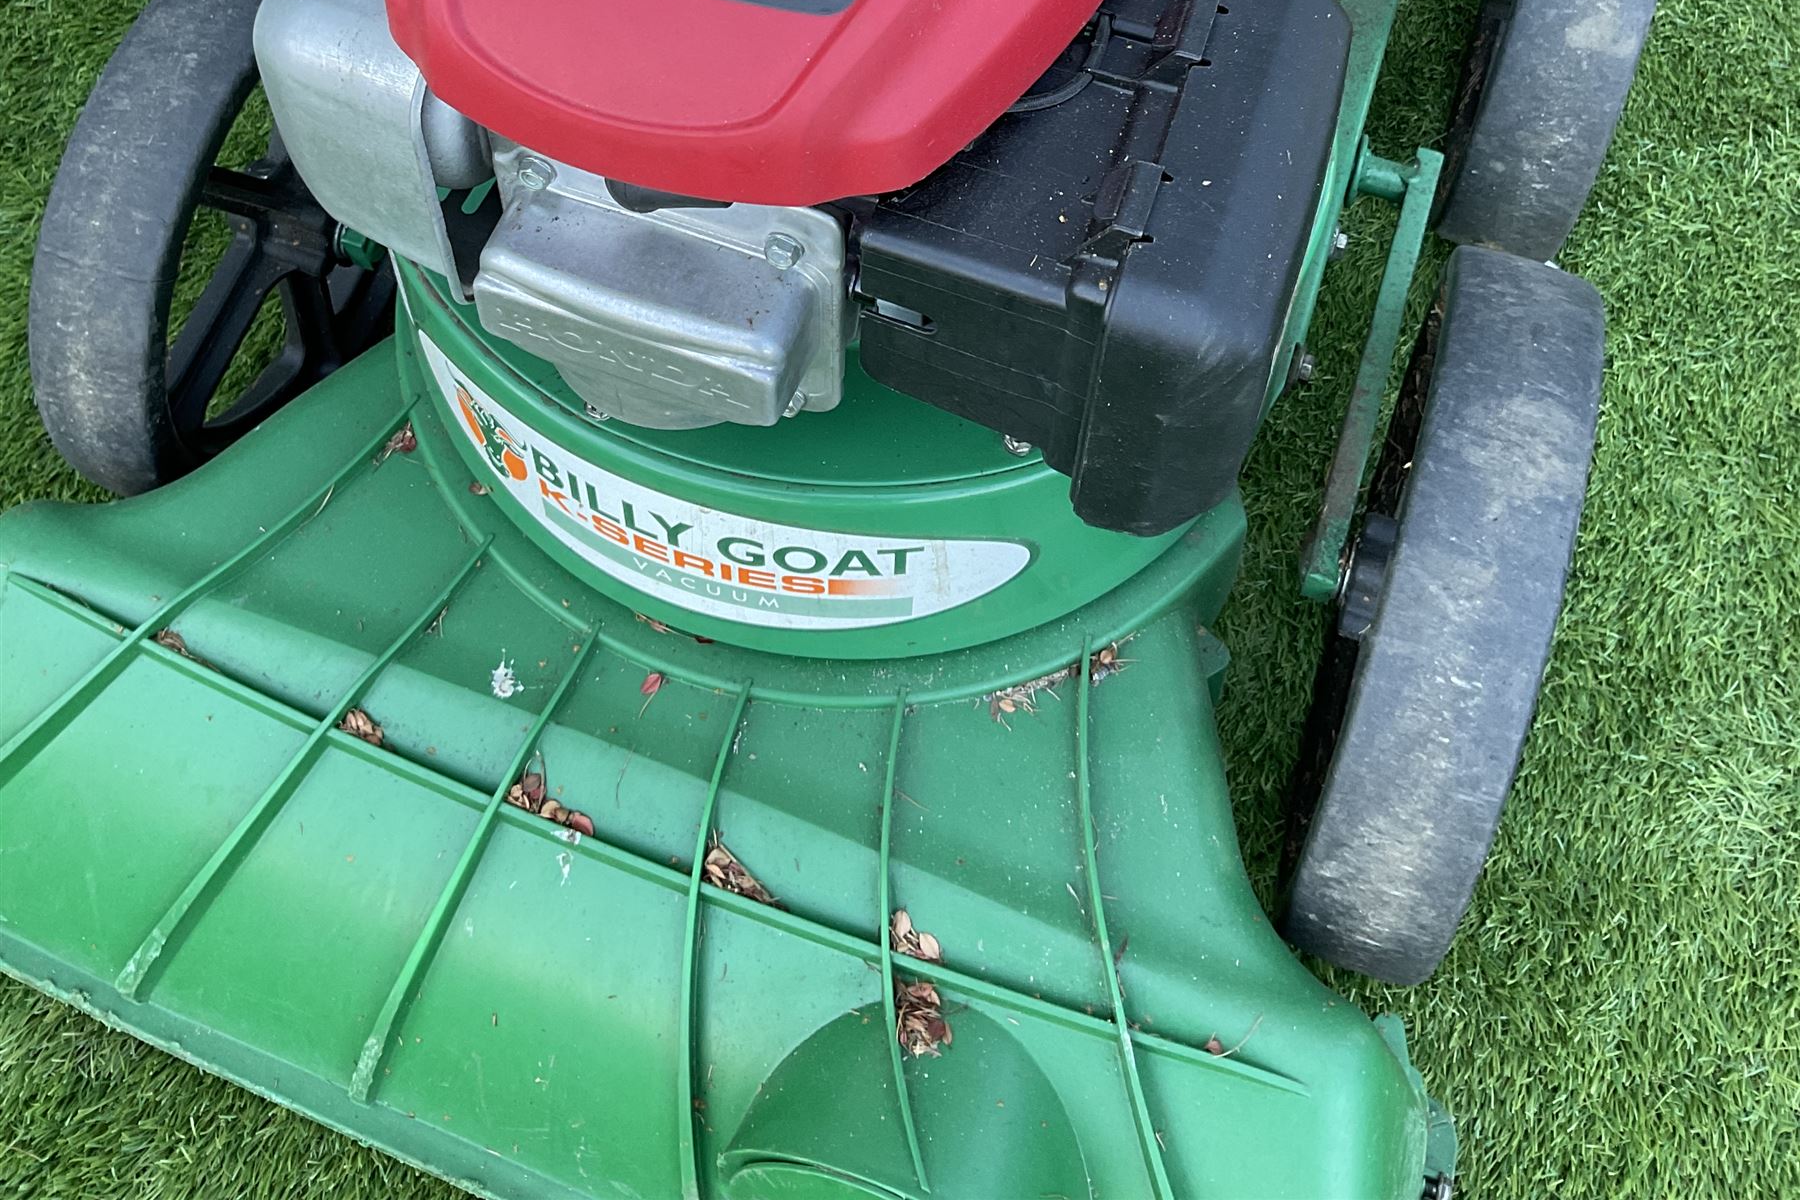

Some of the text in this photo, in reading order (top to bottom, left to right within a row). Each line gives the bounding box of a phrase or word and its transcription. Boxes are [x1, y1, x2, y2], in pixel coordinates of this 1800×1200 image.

[495, 307, 751, 409] HONDA
[530, 444, 925, 577] BILLY GOAT
[539, 478, 826, 595] K-SERIES
[633, 556, 780, 609] VACUUM
